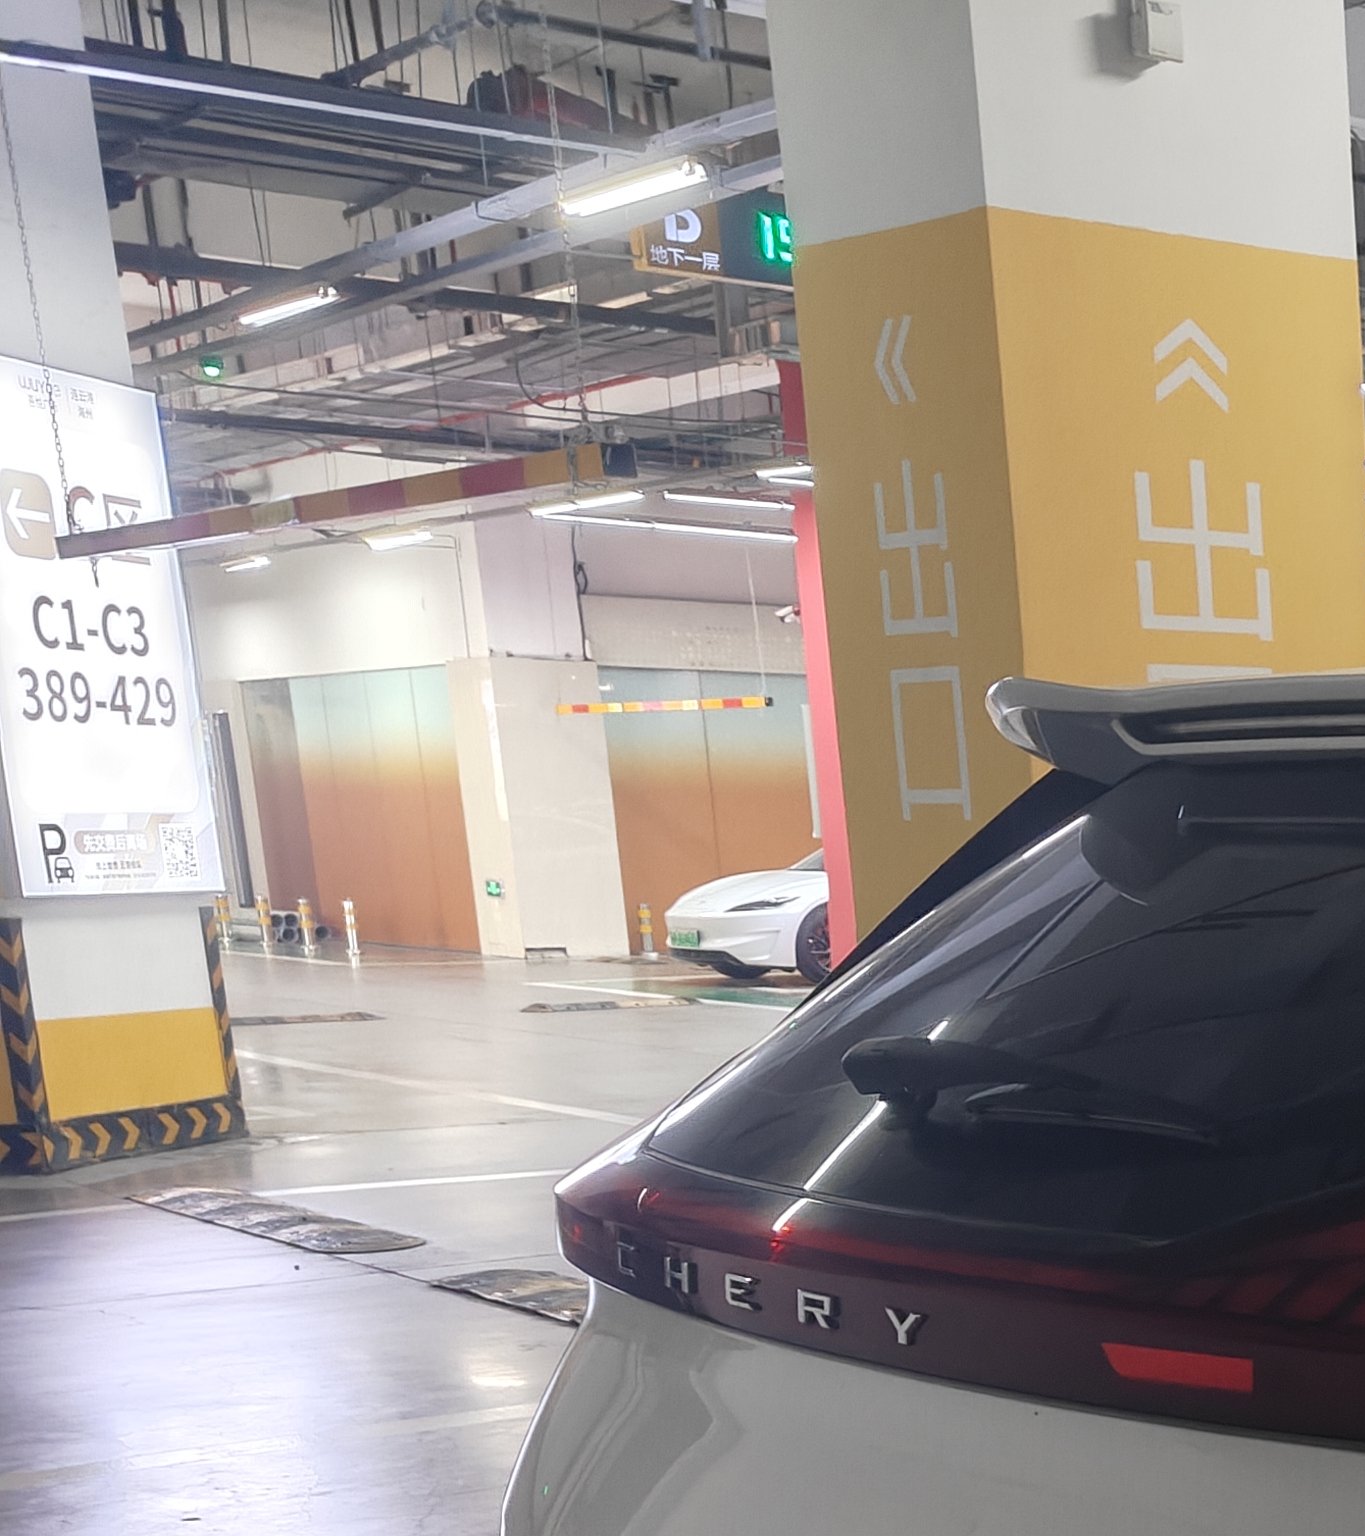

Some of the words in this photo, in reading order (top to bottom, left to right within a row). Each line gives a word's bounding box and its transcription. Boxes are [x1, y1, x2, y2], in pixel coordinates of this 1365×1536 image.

[650, 244, 721, 272] 地下一层
[32, 595, 150, 657] C1-C3
[873, 458, 971, 820] 出口
[18, 667, 177, 728] 389-429
[616, 1241, 922, 1346] CHERY
